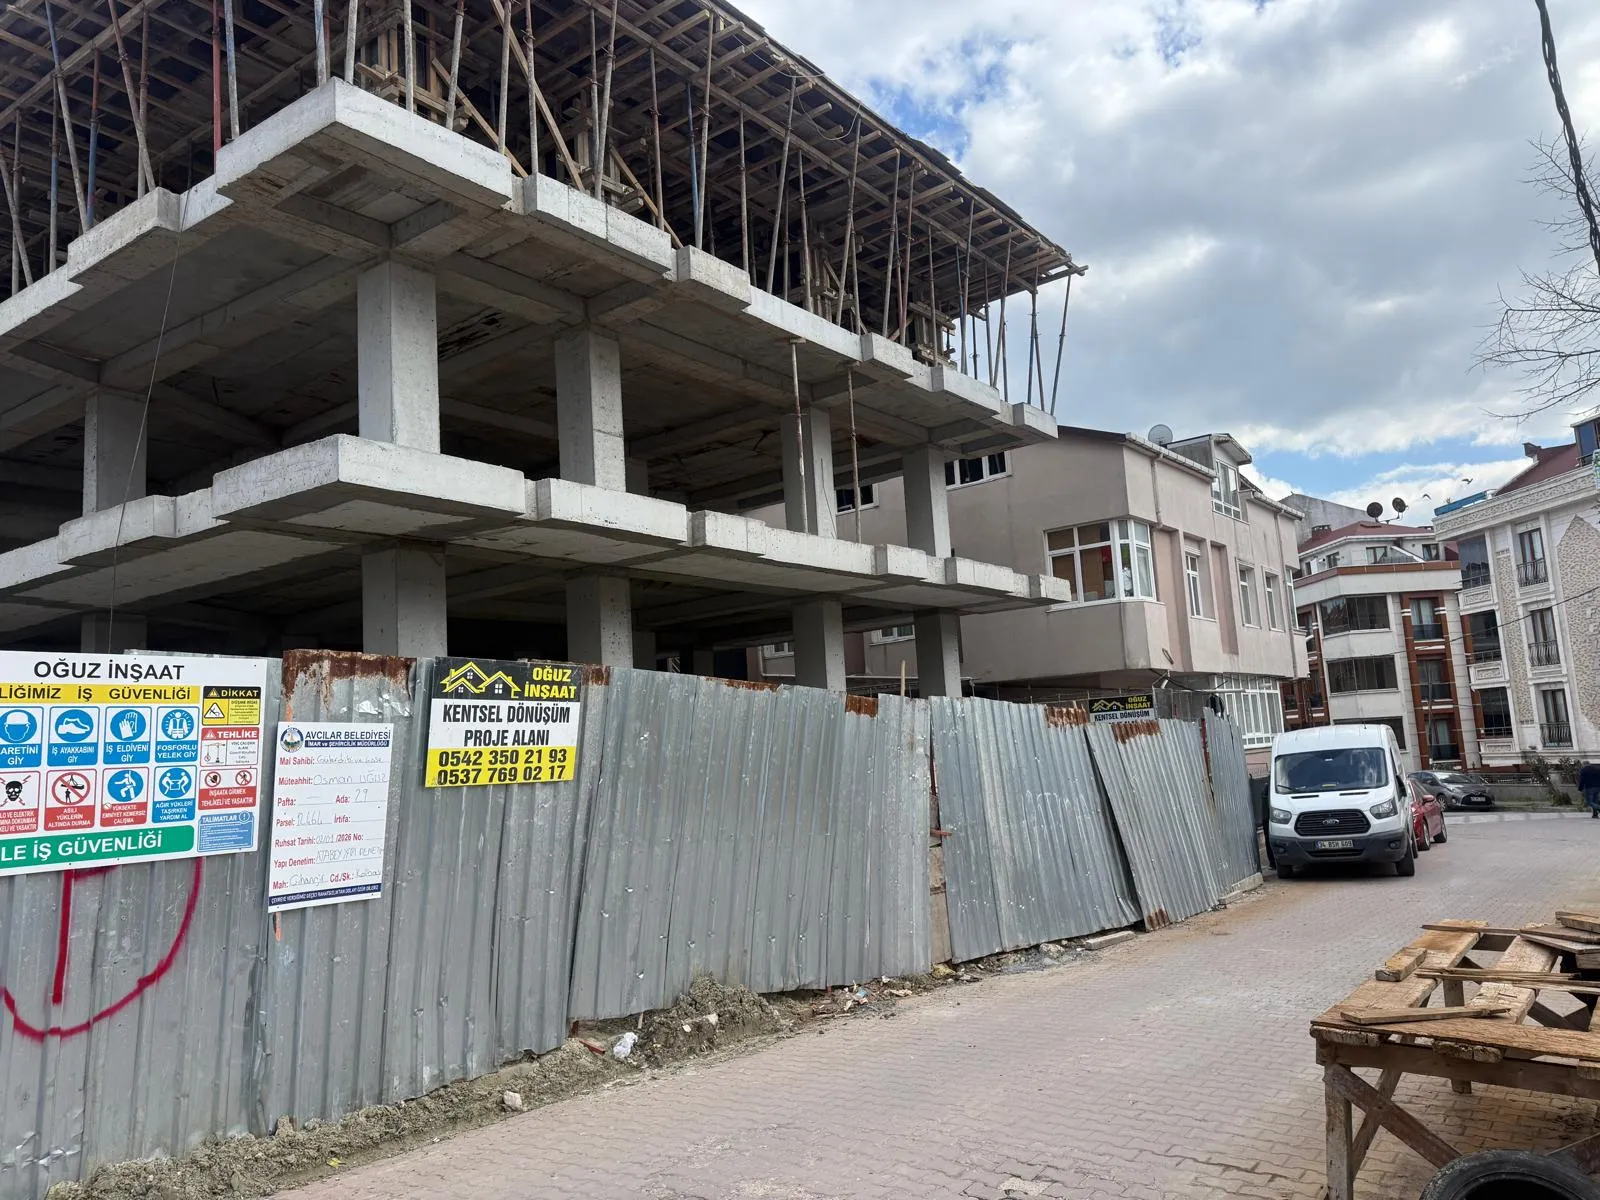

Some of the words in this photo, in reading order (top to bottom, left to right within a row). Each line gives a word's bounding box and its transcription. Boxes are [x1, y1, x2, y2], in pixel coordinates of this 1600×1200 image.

[34, 658, 101, 679] OĞUZ
[108, 659, 185, 682] İNŞAAT
[532, 666, 572, 682] OĞUZ
[0, 685, 61, 699] LİĞİMİZ
[78, 686, 92, 702] İŞ
[109, 686, 190, 700] GÜVENLİĞİ
[221, 688, 259, 697] DİKKAT
[524, 682, 577, 699] İNŞAAT
[442, 704, 502, 723] KENTSEL
[507, 702, 570, 725] DÖNÜŞÜM
[1094, 713, 1119, 721] KENTSEL
[1120, 710, 1150, 720] DÖNÜŞÜM
[217, 730, 258, 738] TEHLİKE
[305, 731, 342, 739] AVCILAR
[344, 730, 390, 740] BELEDİYESİ
[464, 730, 509, 747] PROJE
[512, 730, 550, 746] ALANI
[0, 745, 39, 755] ARETİNİ
[52, 746, 58, 755] İŞ
[106, 743, 113, 755] İŞ
[117, 743, 149, 752] ELDİVENİ
[8, 756, 24, 765] GİY
[68, 755, 78, 763] GİY
[121, 754, 134, 762] GİY
[280, 757, 290, 765] Mal
[293, 756, 315, 765] Sahibi:
[439, 750, 483, 767] 0542
[488, 750, 519, 766] 350
[524, 749, 542, 764] 21
[548, 748, 567, 763] 93
[438, 768, 481, 785] 0537
[488, 767, 518, 783] 769
[523, 766, 542, 781] 02
[548, 765, 566, 780] 17
[279, 776, 313, 785] Müteahhit:
[278, 797, 296, 807] Pafta:
[336, 795, 351, 804] Ada:
[156, 801, 169, 809] AĞIR
[276, 818, 295, 827] Parsel:
[352, 832, 364, 841] No:
[1, 845, 27, 861] LE
[34, 840, 52, 861] İŞ
[58, 830, 162, 856] GÜVENLİĞİ
[274, 838, 296, 848] Ruhsat
[298, 837, 316, 846] Tarihi:
[274, 860, 288, 869] Yapı
[289, 857, 316, 867] Denetim:
[272, 880, 289, 890] Mah:
